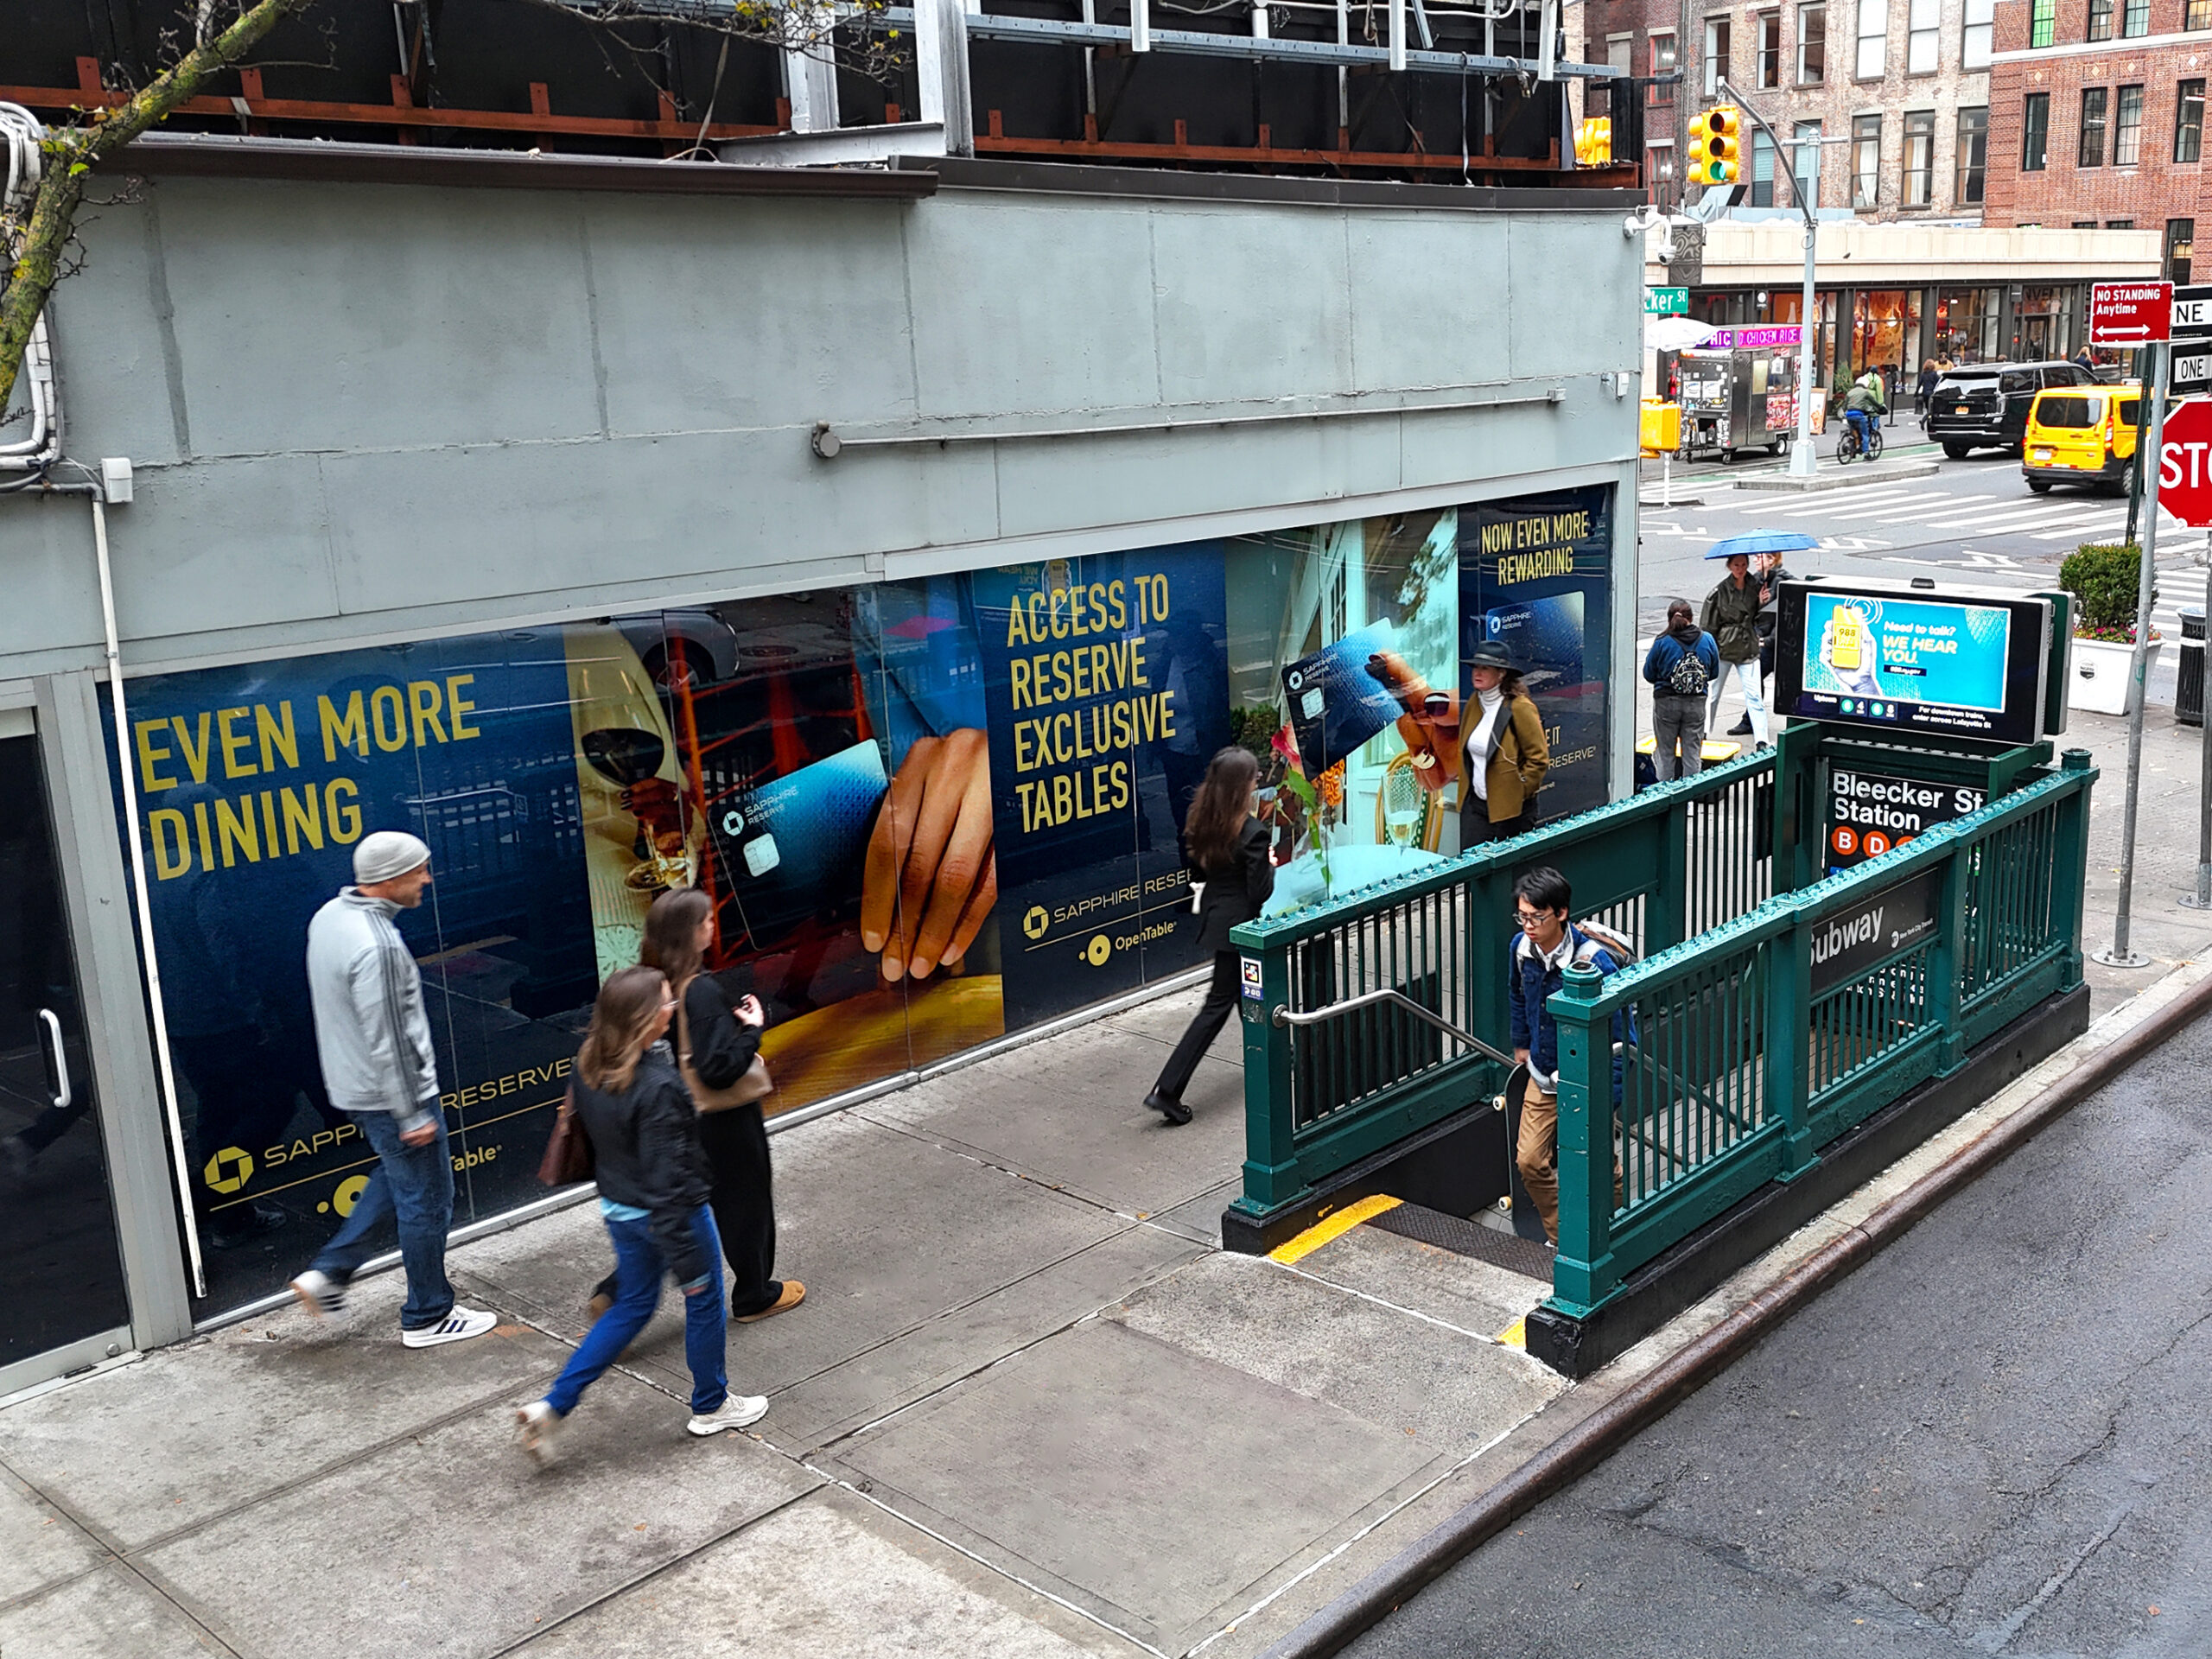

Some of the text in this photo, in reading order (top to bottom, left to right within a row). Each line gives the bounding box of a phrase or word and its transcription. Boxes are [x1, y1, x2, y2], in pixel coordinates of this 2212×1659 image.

[1677, 290, 1686, 302] St
[2097, 289, 2160, 302] NO STANDING
[2096, 303, 2137, 317] Anytime
[2177, 303, 2203, 323] NE
[1746, 331, 1777, 345] CHICKEN
[1780, 329, 1796, 342] RICE
[2181, 359, 2203, 378] ONE
[2159, 442, 2212, 489] ST
[1482, 511, 1589, 555] NOW EVEN MORE
[1498, 546, 1573, 586] REWARDING
[1007, 574, 1168, 647] ACCESS TO
[1884, 620, 1956, 636] Need to talk?
[1883, 634, 1957, 654] WE HEAR
[1883, 648, 1918, 664] YOU.
[1010, 637, 1147, 710] RESERVE
[1857, 701, 1864, 709] 4
[135, 674, 480, 793] EVEN MORE
[1014, 690, 1175, 772] EXCLUSIVE
[1553, 726, 1560, 746] IT
[1548, 747, 1595, 770] RESERVE
[745, 785, 798, 817] SAPPHIRE
[1016, 761, 1128, 833] TABLES
[1833, 772, 1983, 813] Bleecker St
[748, 804, 785, 825] RESERVE
[1835, 798, 1920, 830] Station
[148, 778, 363, 880] DINING
[1839, 832, 1884, 854] B D
[1054, 868, 1192, 924] SAPPHIRE RESE
[1116, 922, 1175, 950] OpenTable
[264, 1058, 571, 1168] SAPP RESERVE
